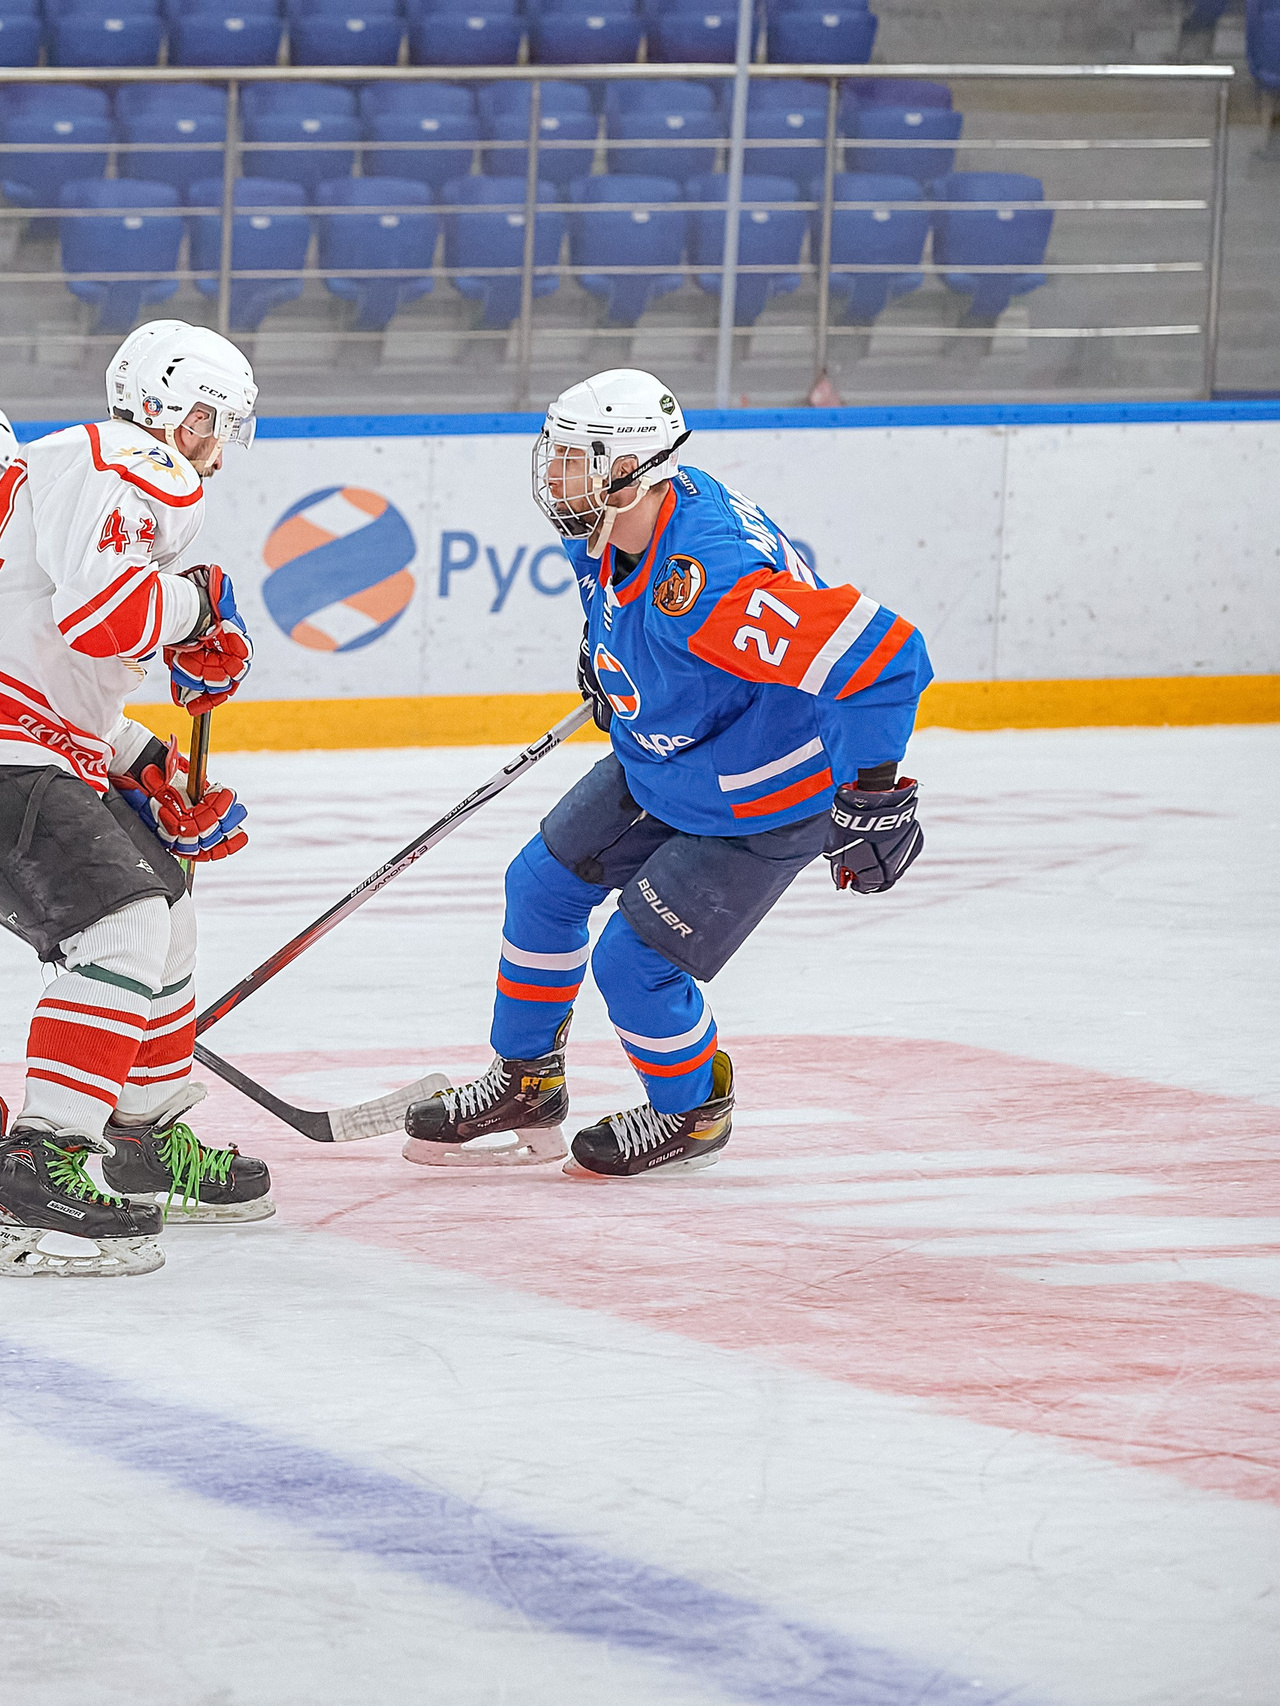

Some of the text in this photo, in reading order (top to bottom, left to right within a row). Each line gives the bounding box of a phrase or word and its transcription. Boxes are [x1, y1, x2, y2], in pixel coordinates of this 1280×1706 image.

[199, 384, 228, 401] CCM
[731, 587, 801, 668] 27
[637, 877, 694, 939] BAUER
